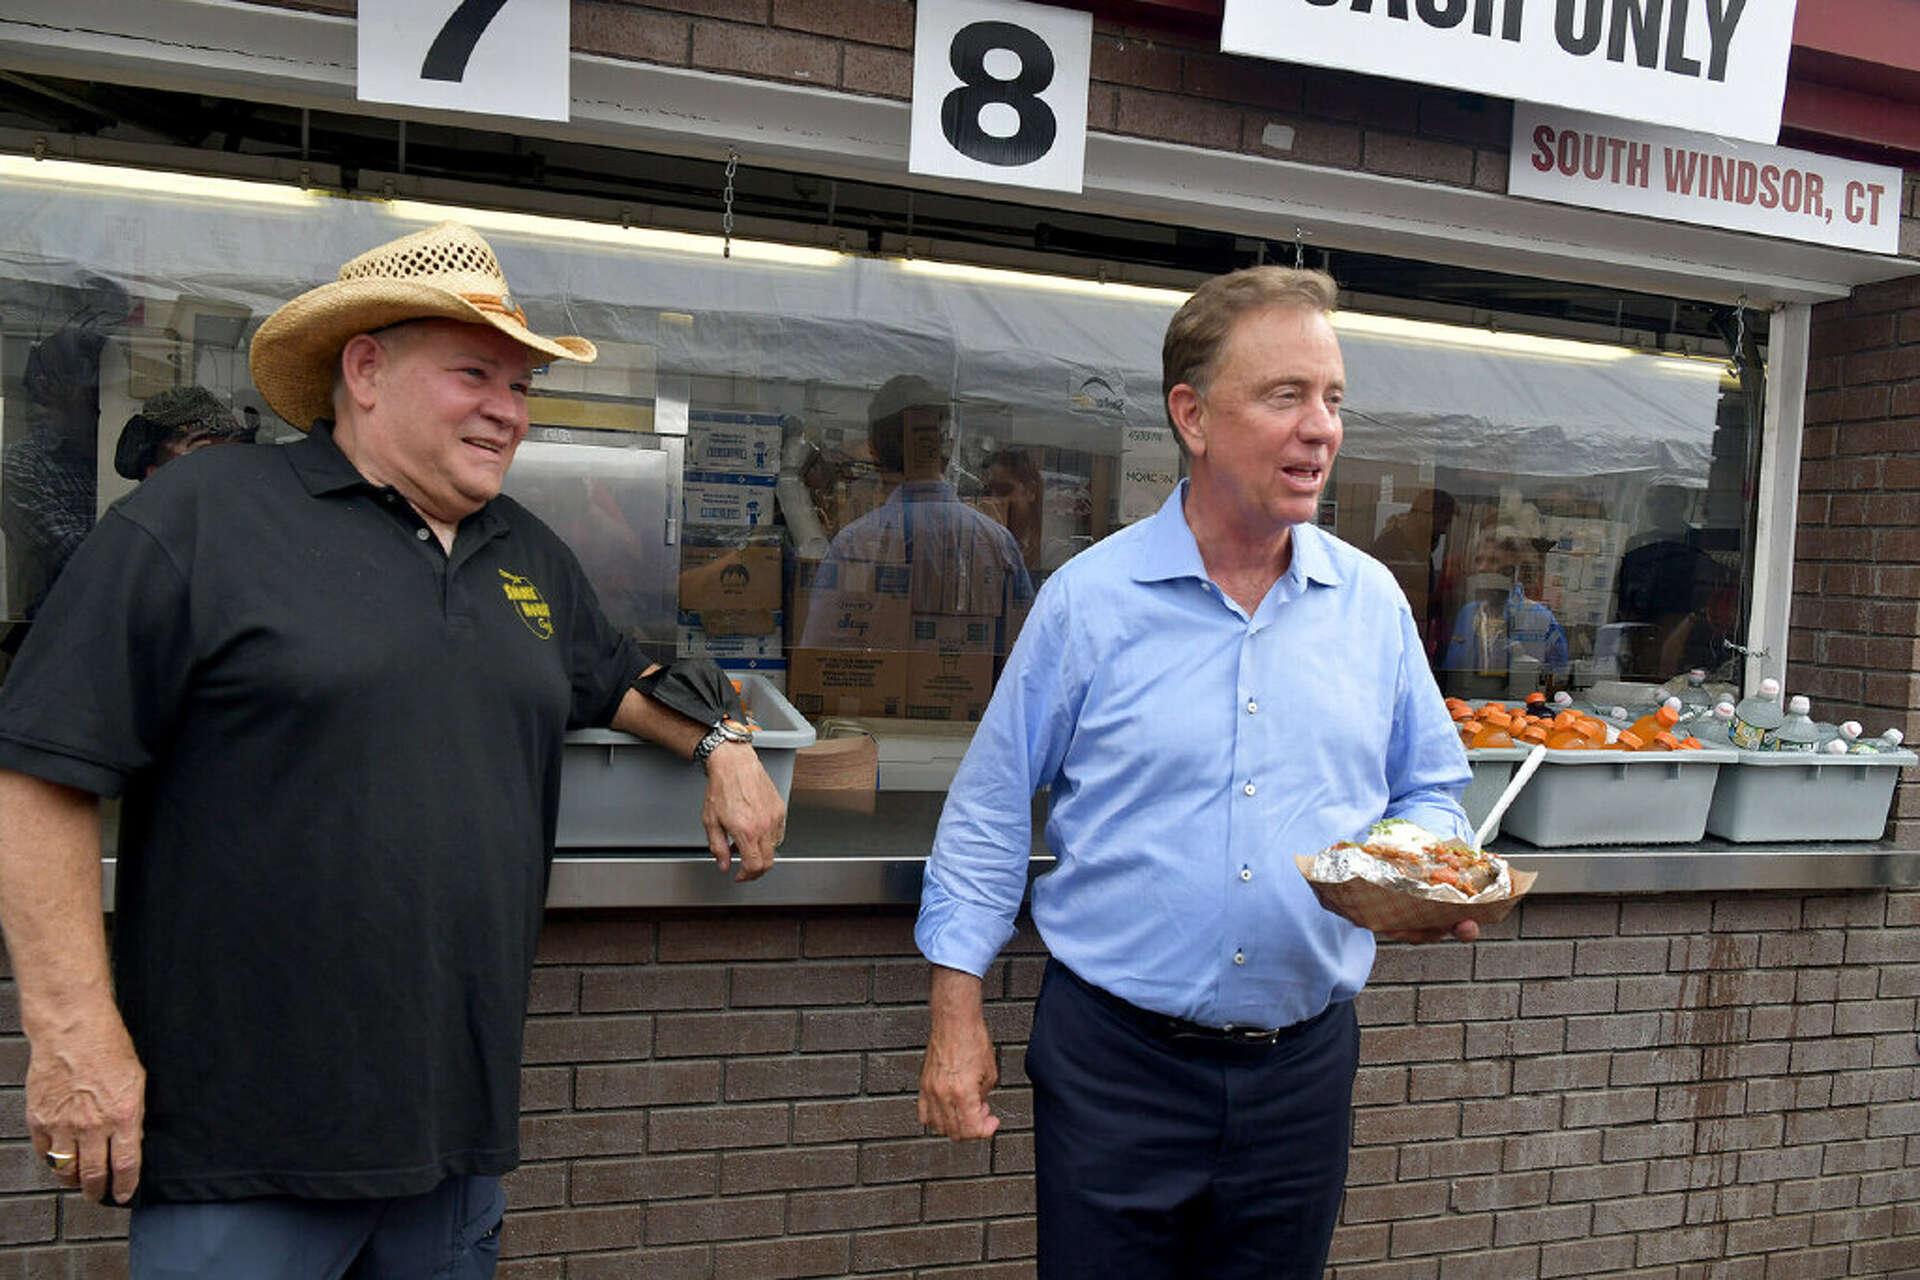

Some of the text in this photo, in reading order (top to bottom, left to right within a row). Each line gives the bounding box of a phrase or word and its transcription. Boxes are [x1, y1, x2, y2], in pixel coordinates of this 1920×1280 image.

[940, 20, 1057, 166] 8
[1531, 125, 1885, 226] SOUTH WINDSOR, CT
